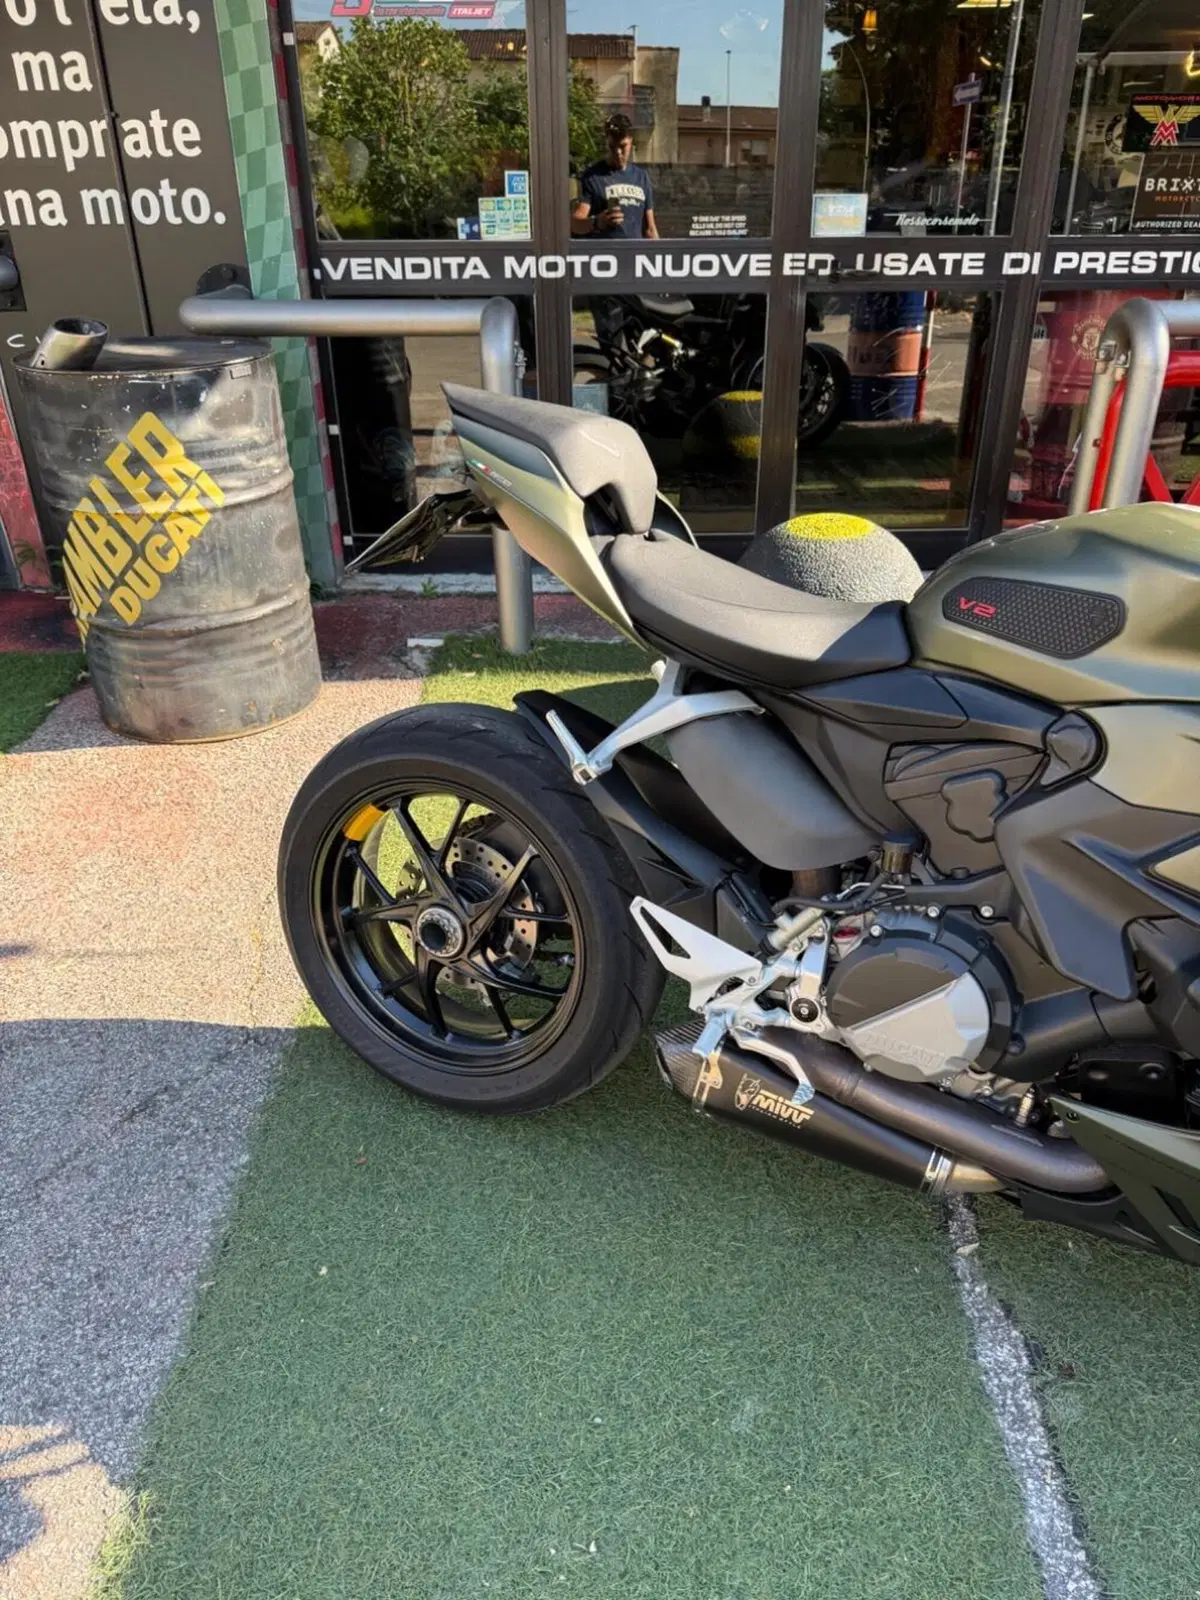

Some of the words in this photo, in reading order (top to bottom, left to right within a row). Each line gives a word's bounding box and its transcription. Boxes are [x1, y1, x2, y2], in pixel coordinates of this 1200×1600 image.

[11, 51, 93, 92] ma
[0, 109, 202, 173] mprate
[0, 188, 68, 226] na
[80, 178, 226, 225] moto.
[1135, 220, 1181, 228] AUTHORIZED
[1183, 220, 1200, 228] DEA
[321, 256, 490, 280] VENDITA
[504, 255, 618, 279] MOTO
[635, 253, 772, 278] NUOVE
[783, 252, 836, 276] ED
[856, 252, 986, 276] USATE
[1002, 252, 1042, 275] DI
[110, 470, 227, 627] DUCATI
[958, 596, 997, 618] V2
